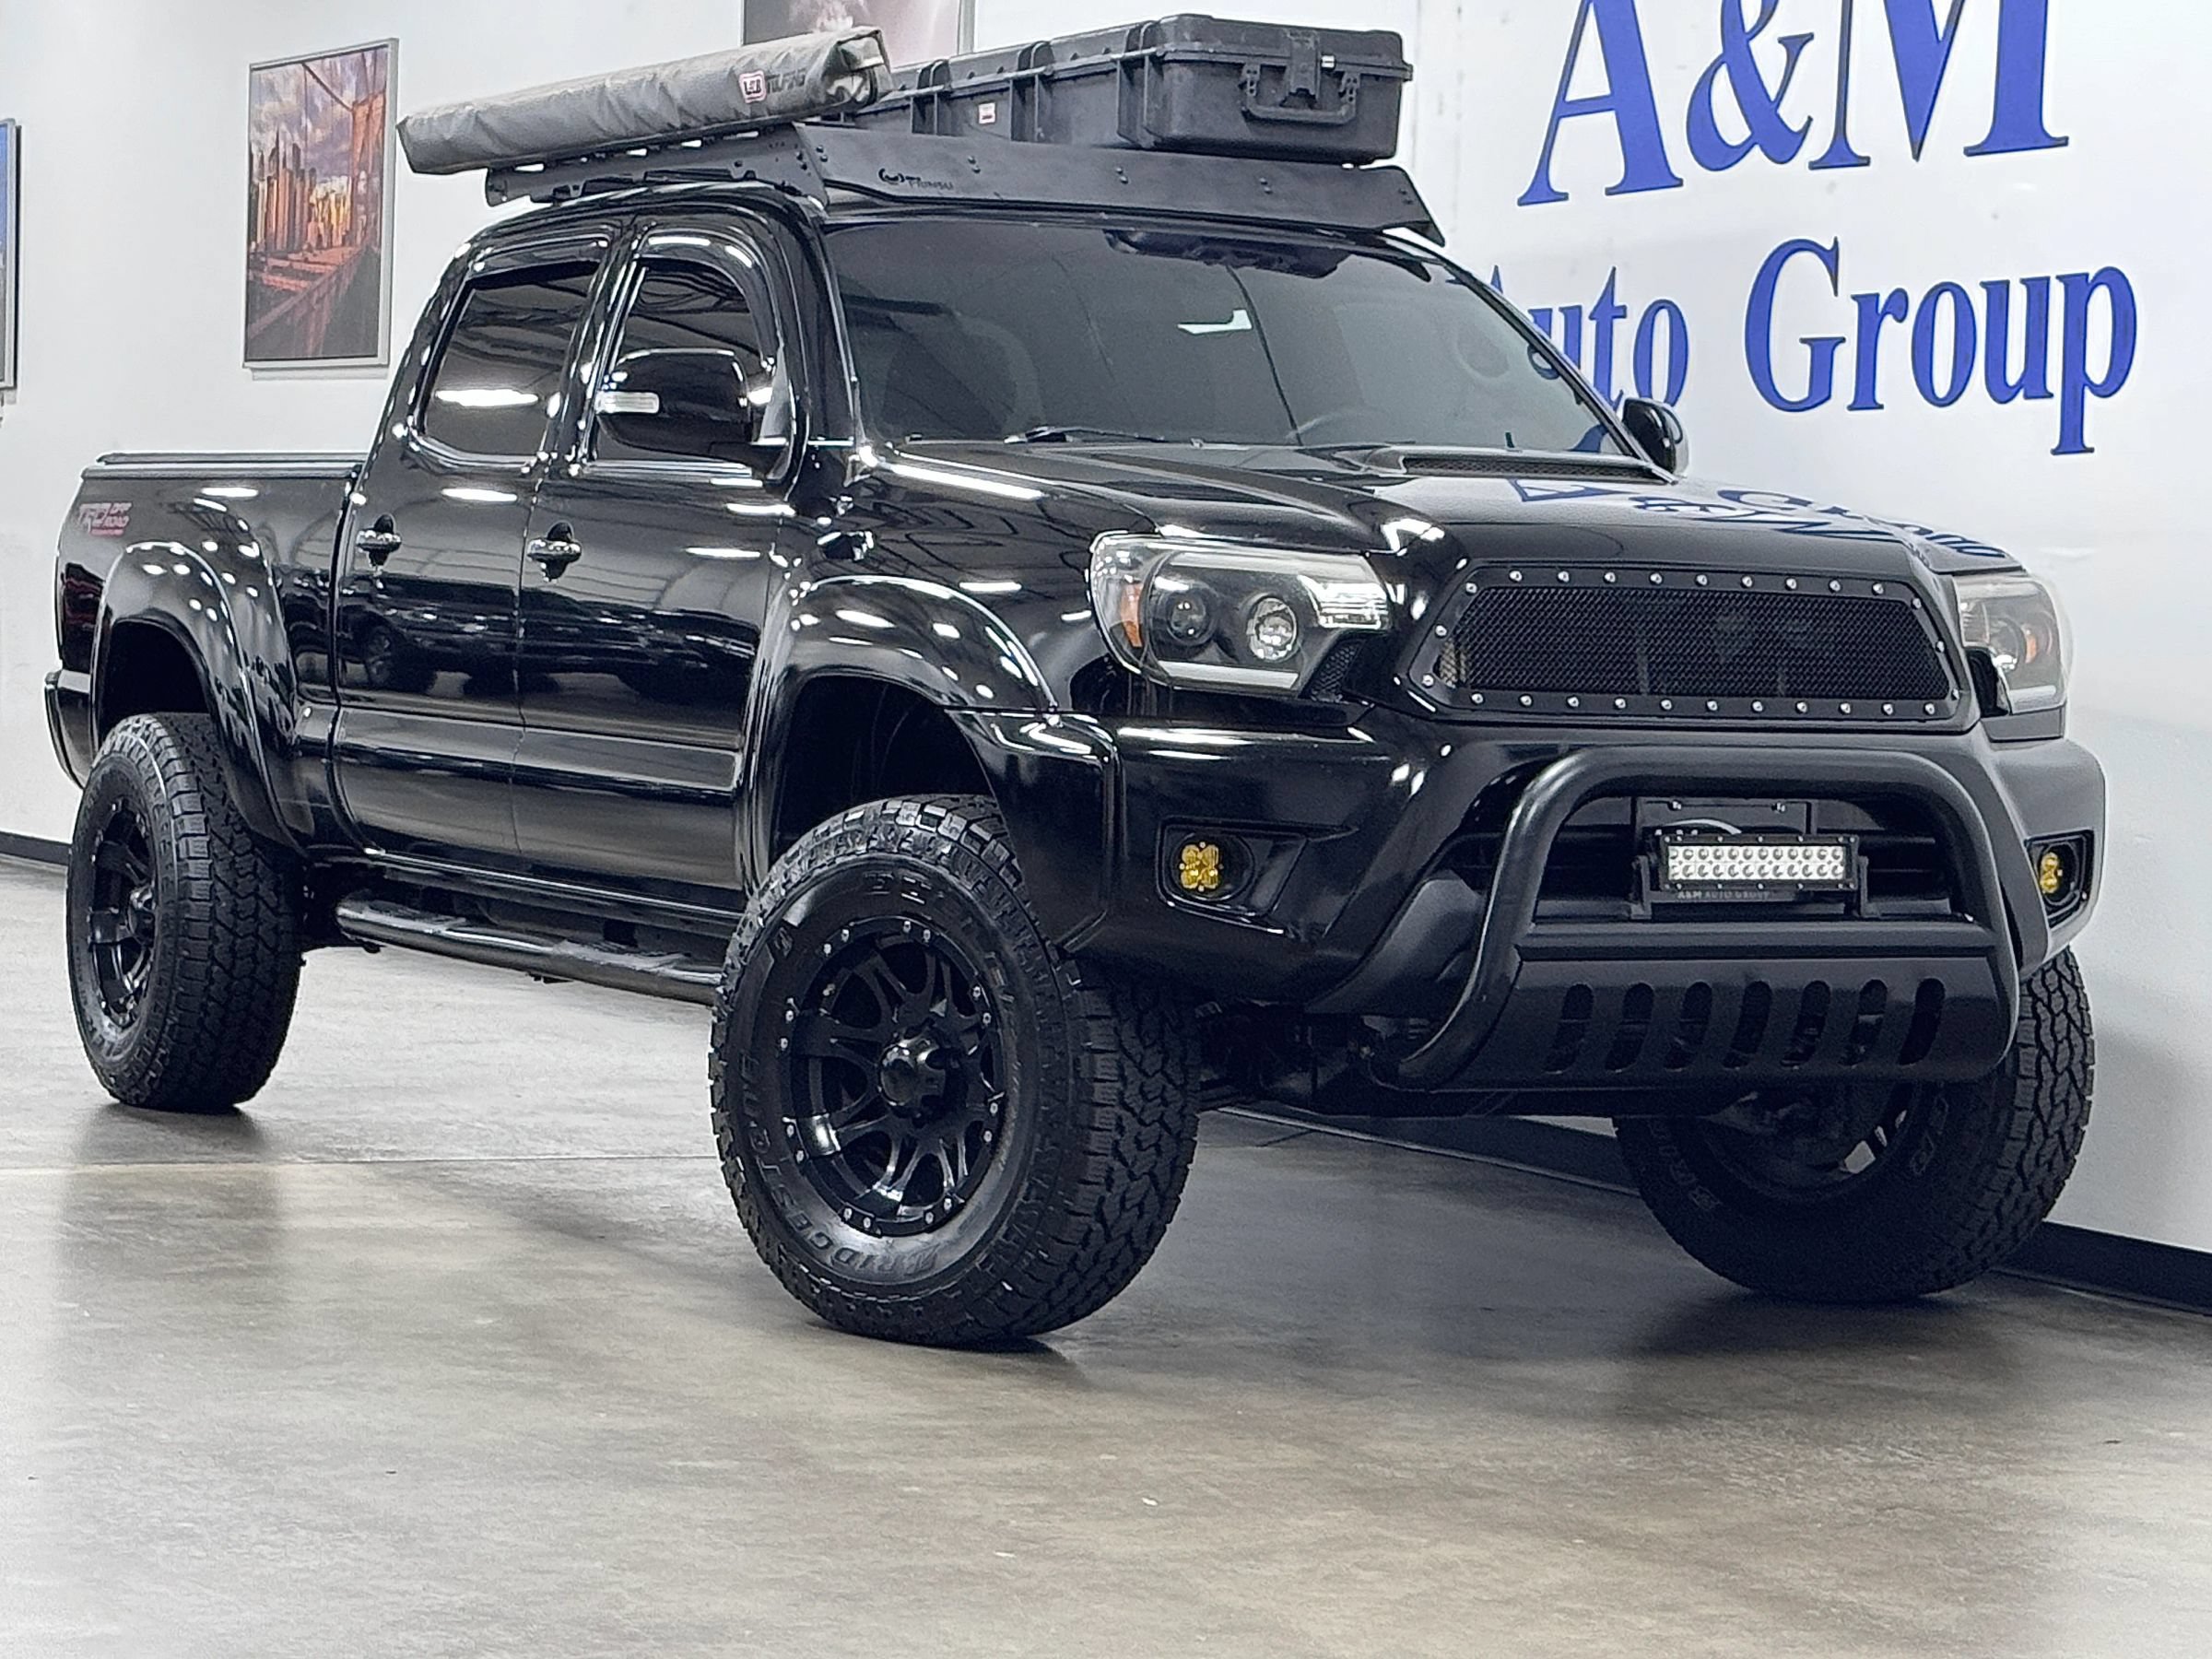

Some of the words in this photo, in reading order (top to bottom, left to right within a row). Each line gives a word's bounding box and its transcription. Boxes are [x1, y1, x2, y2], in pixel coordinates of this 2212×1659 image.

[1517, 0, 2069, 206] A&M
[1489, 265, 1689, 408] uto
[1745, 236, 2138, 456] Group
